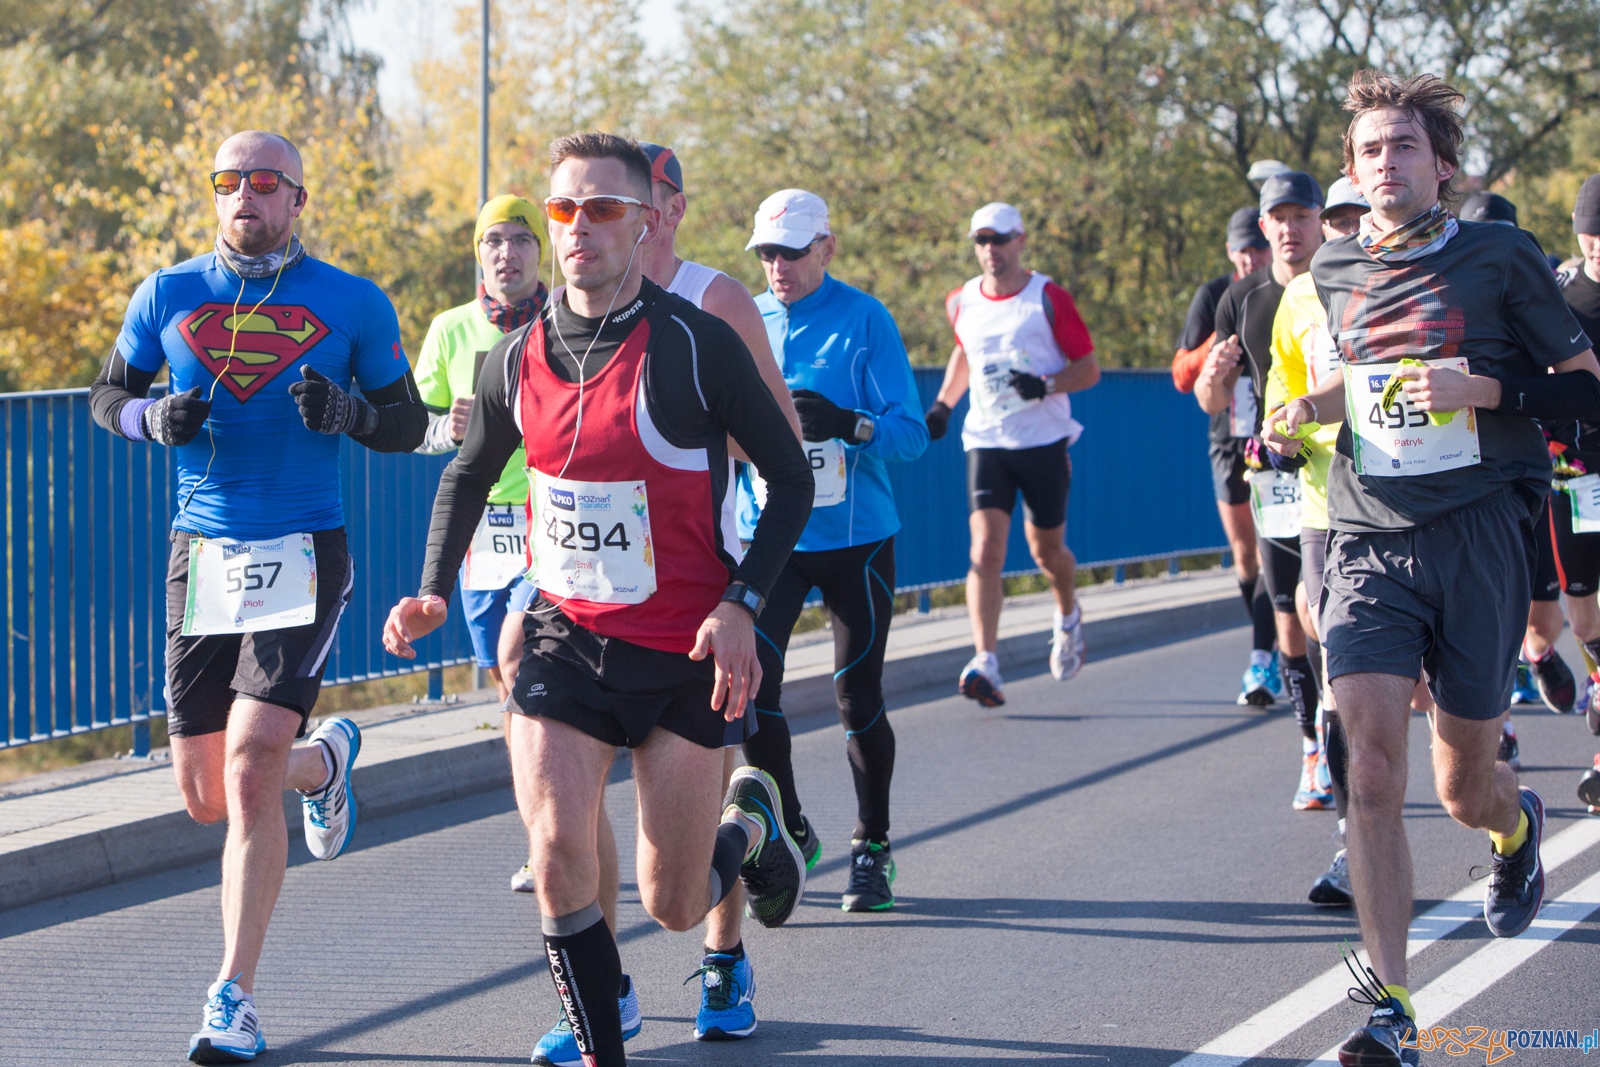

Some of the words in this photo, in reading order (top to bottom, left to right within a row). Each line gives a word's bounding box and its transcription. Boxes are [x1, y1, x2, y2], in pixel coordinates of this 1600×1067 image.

[1394, 437, 1424, 447] Patryk
[546, 516, 631, 552] 4294
[576, 560, 593, 570] Emil
[226, 561, 283, 594] 557
[243, 599, 265, 608] Piotr
